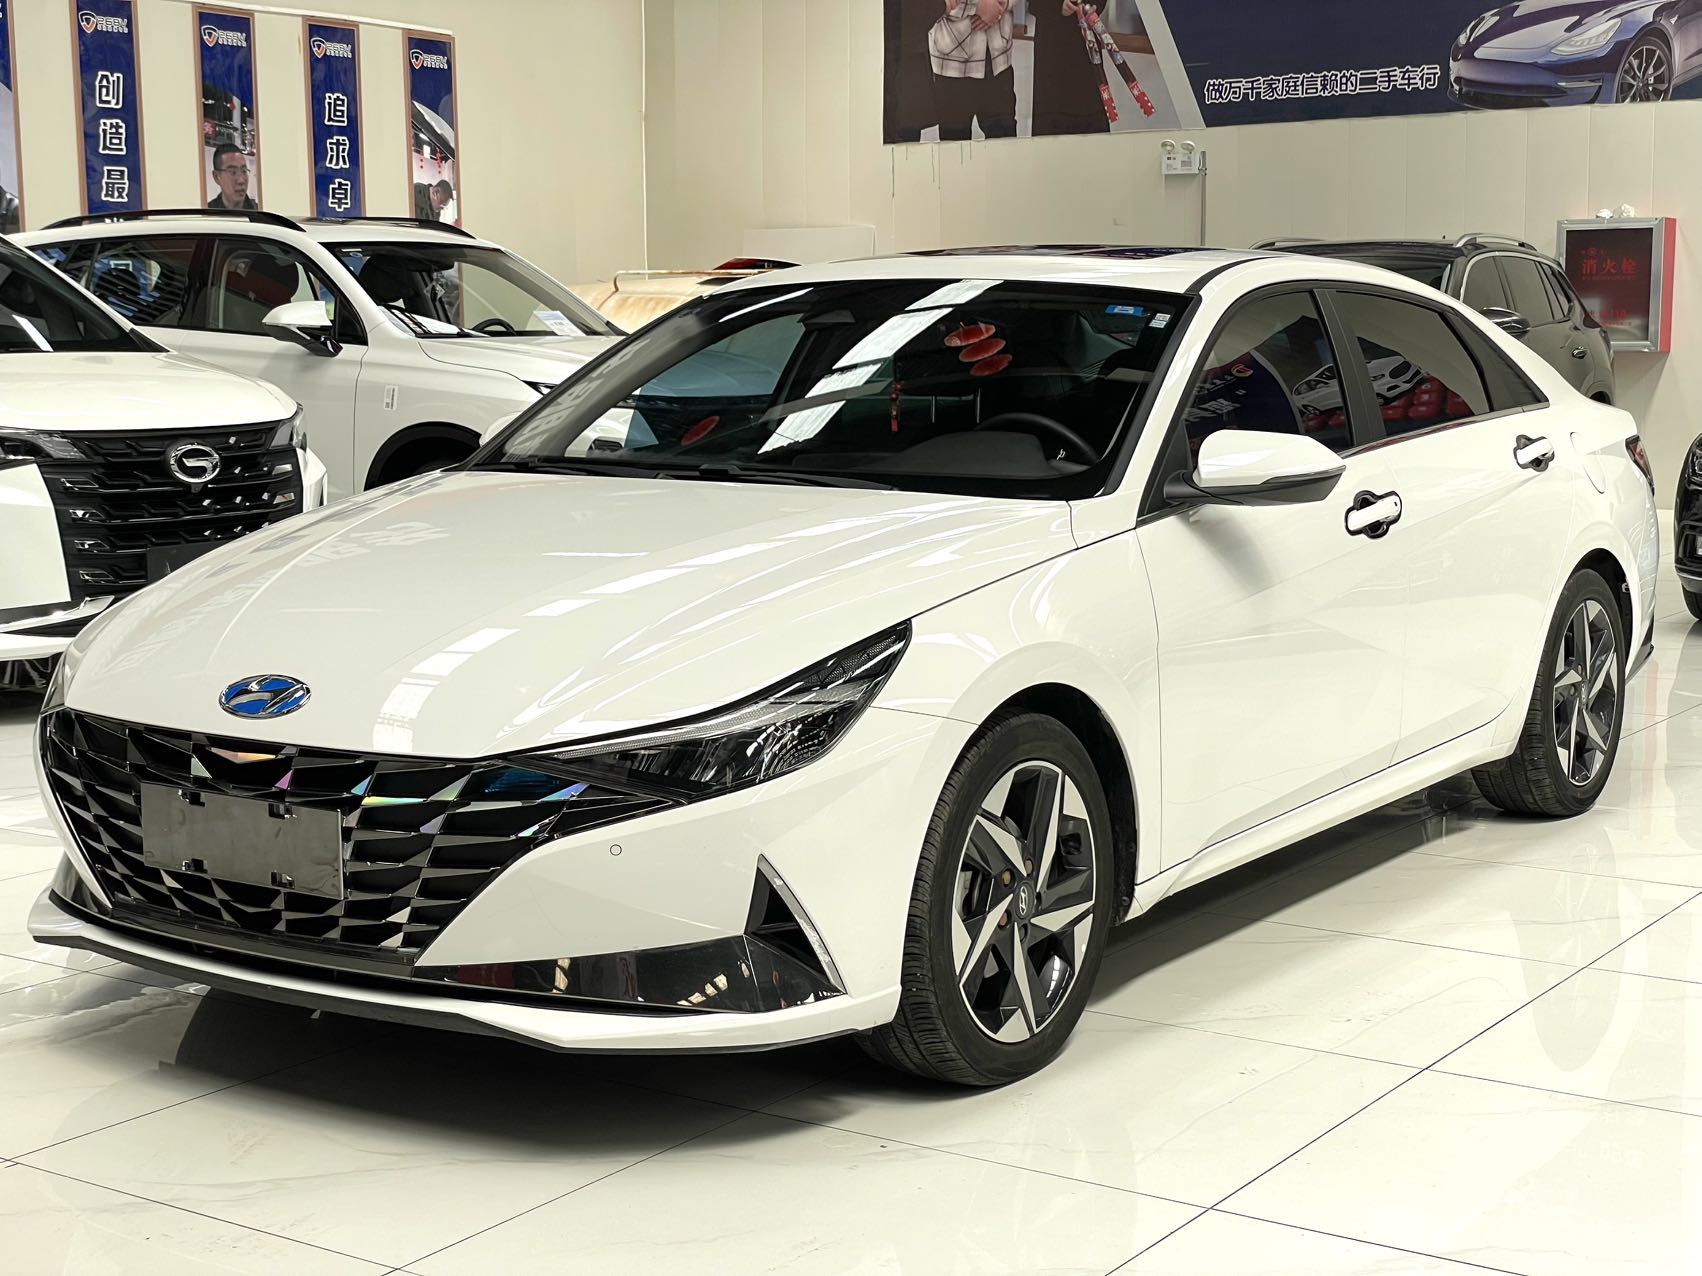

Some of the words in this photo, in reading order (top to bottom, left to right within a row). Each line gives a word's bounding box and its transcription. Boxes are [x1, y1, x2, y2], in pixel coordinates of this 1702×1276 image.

[1204, 64, 1441, 104] 做万千家庭信赖的二手车行
[96, 71, 129, 223] 创造最
[325, 93, 351, 212] 追求卓
[1582, 256, 1636, 274] 消火栓
